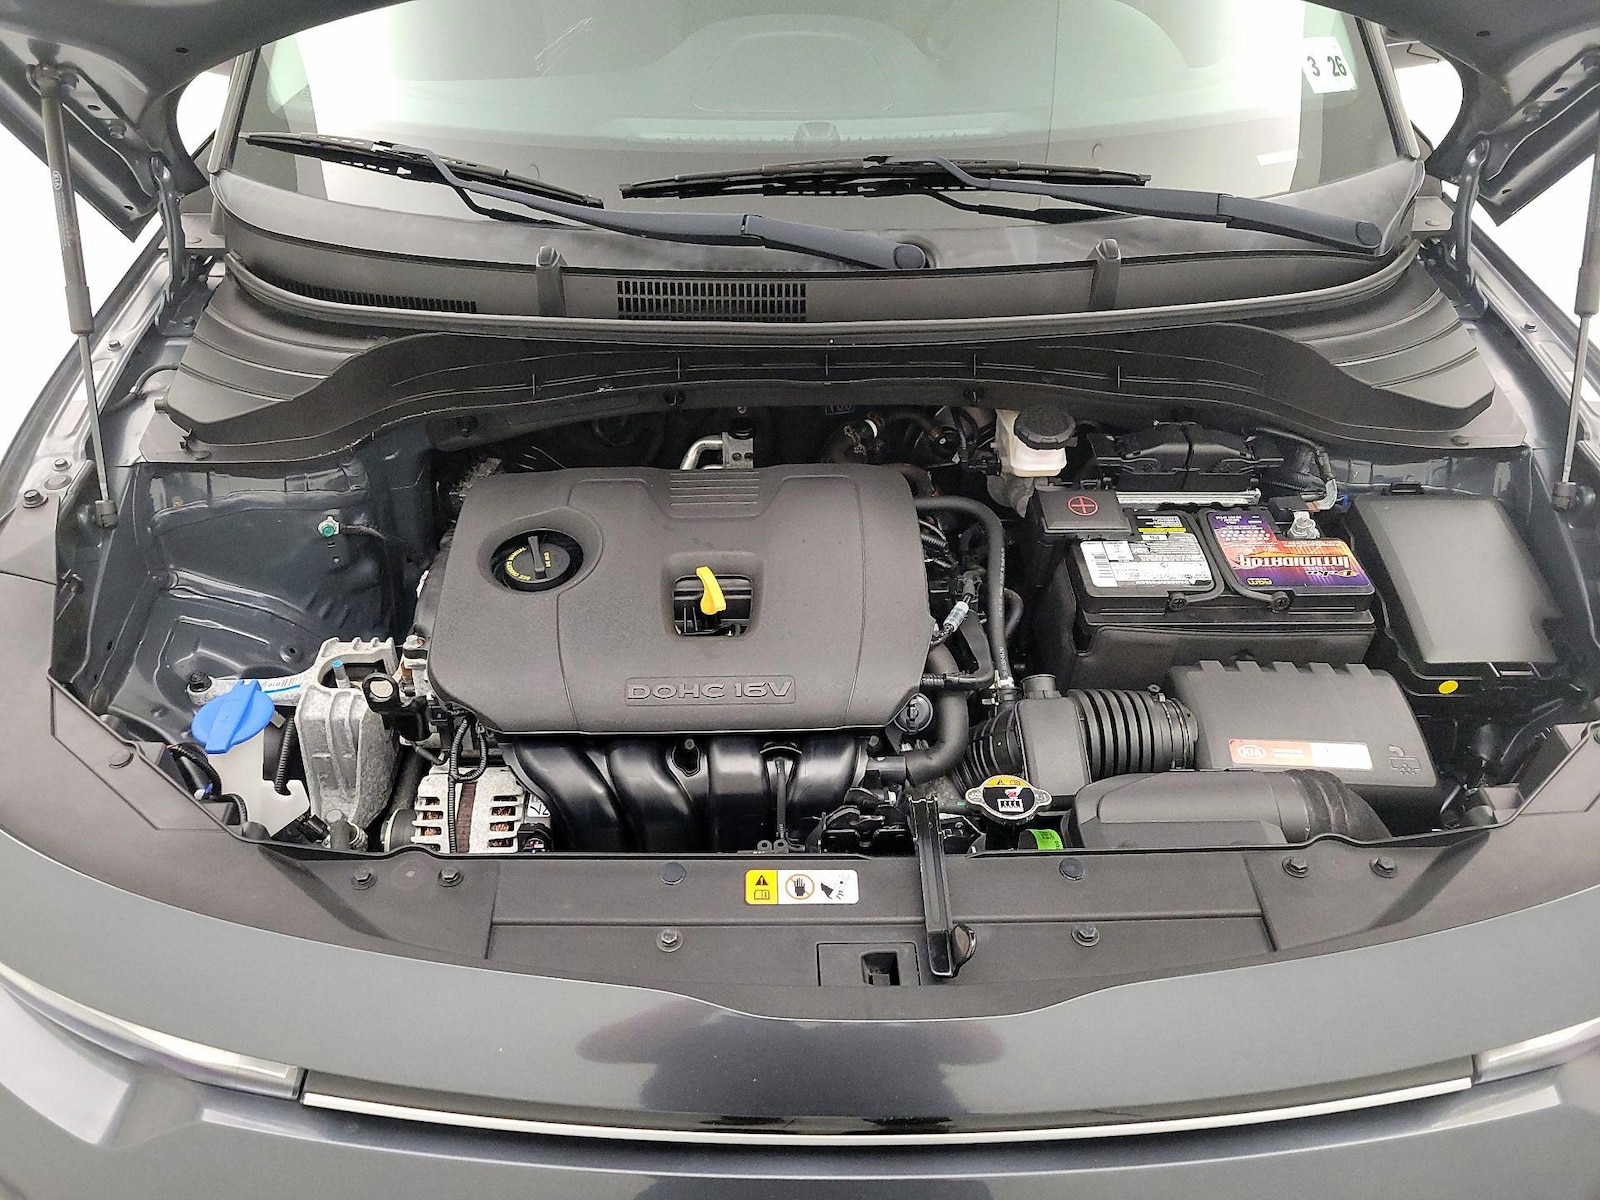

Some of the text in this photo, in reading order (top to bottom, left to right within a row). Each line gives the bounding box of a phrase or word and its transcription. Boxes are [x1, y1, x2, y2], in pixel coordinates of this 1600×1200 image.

[1307, 55, 1347, 77] 3 26
[53, 171, 62, 190] KIA
[627, 681, 792, 700] DOHC 16V
